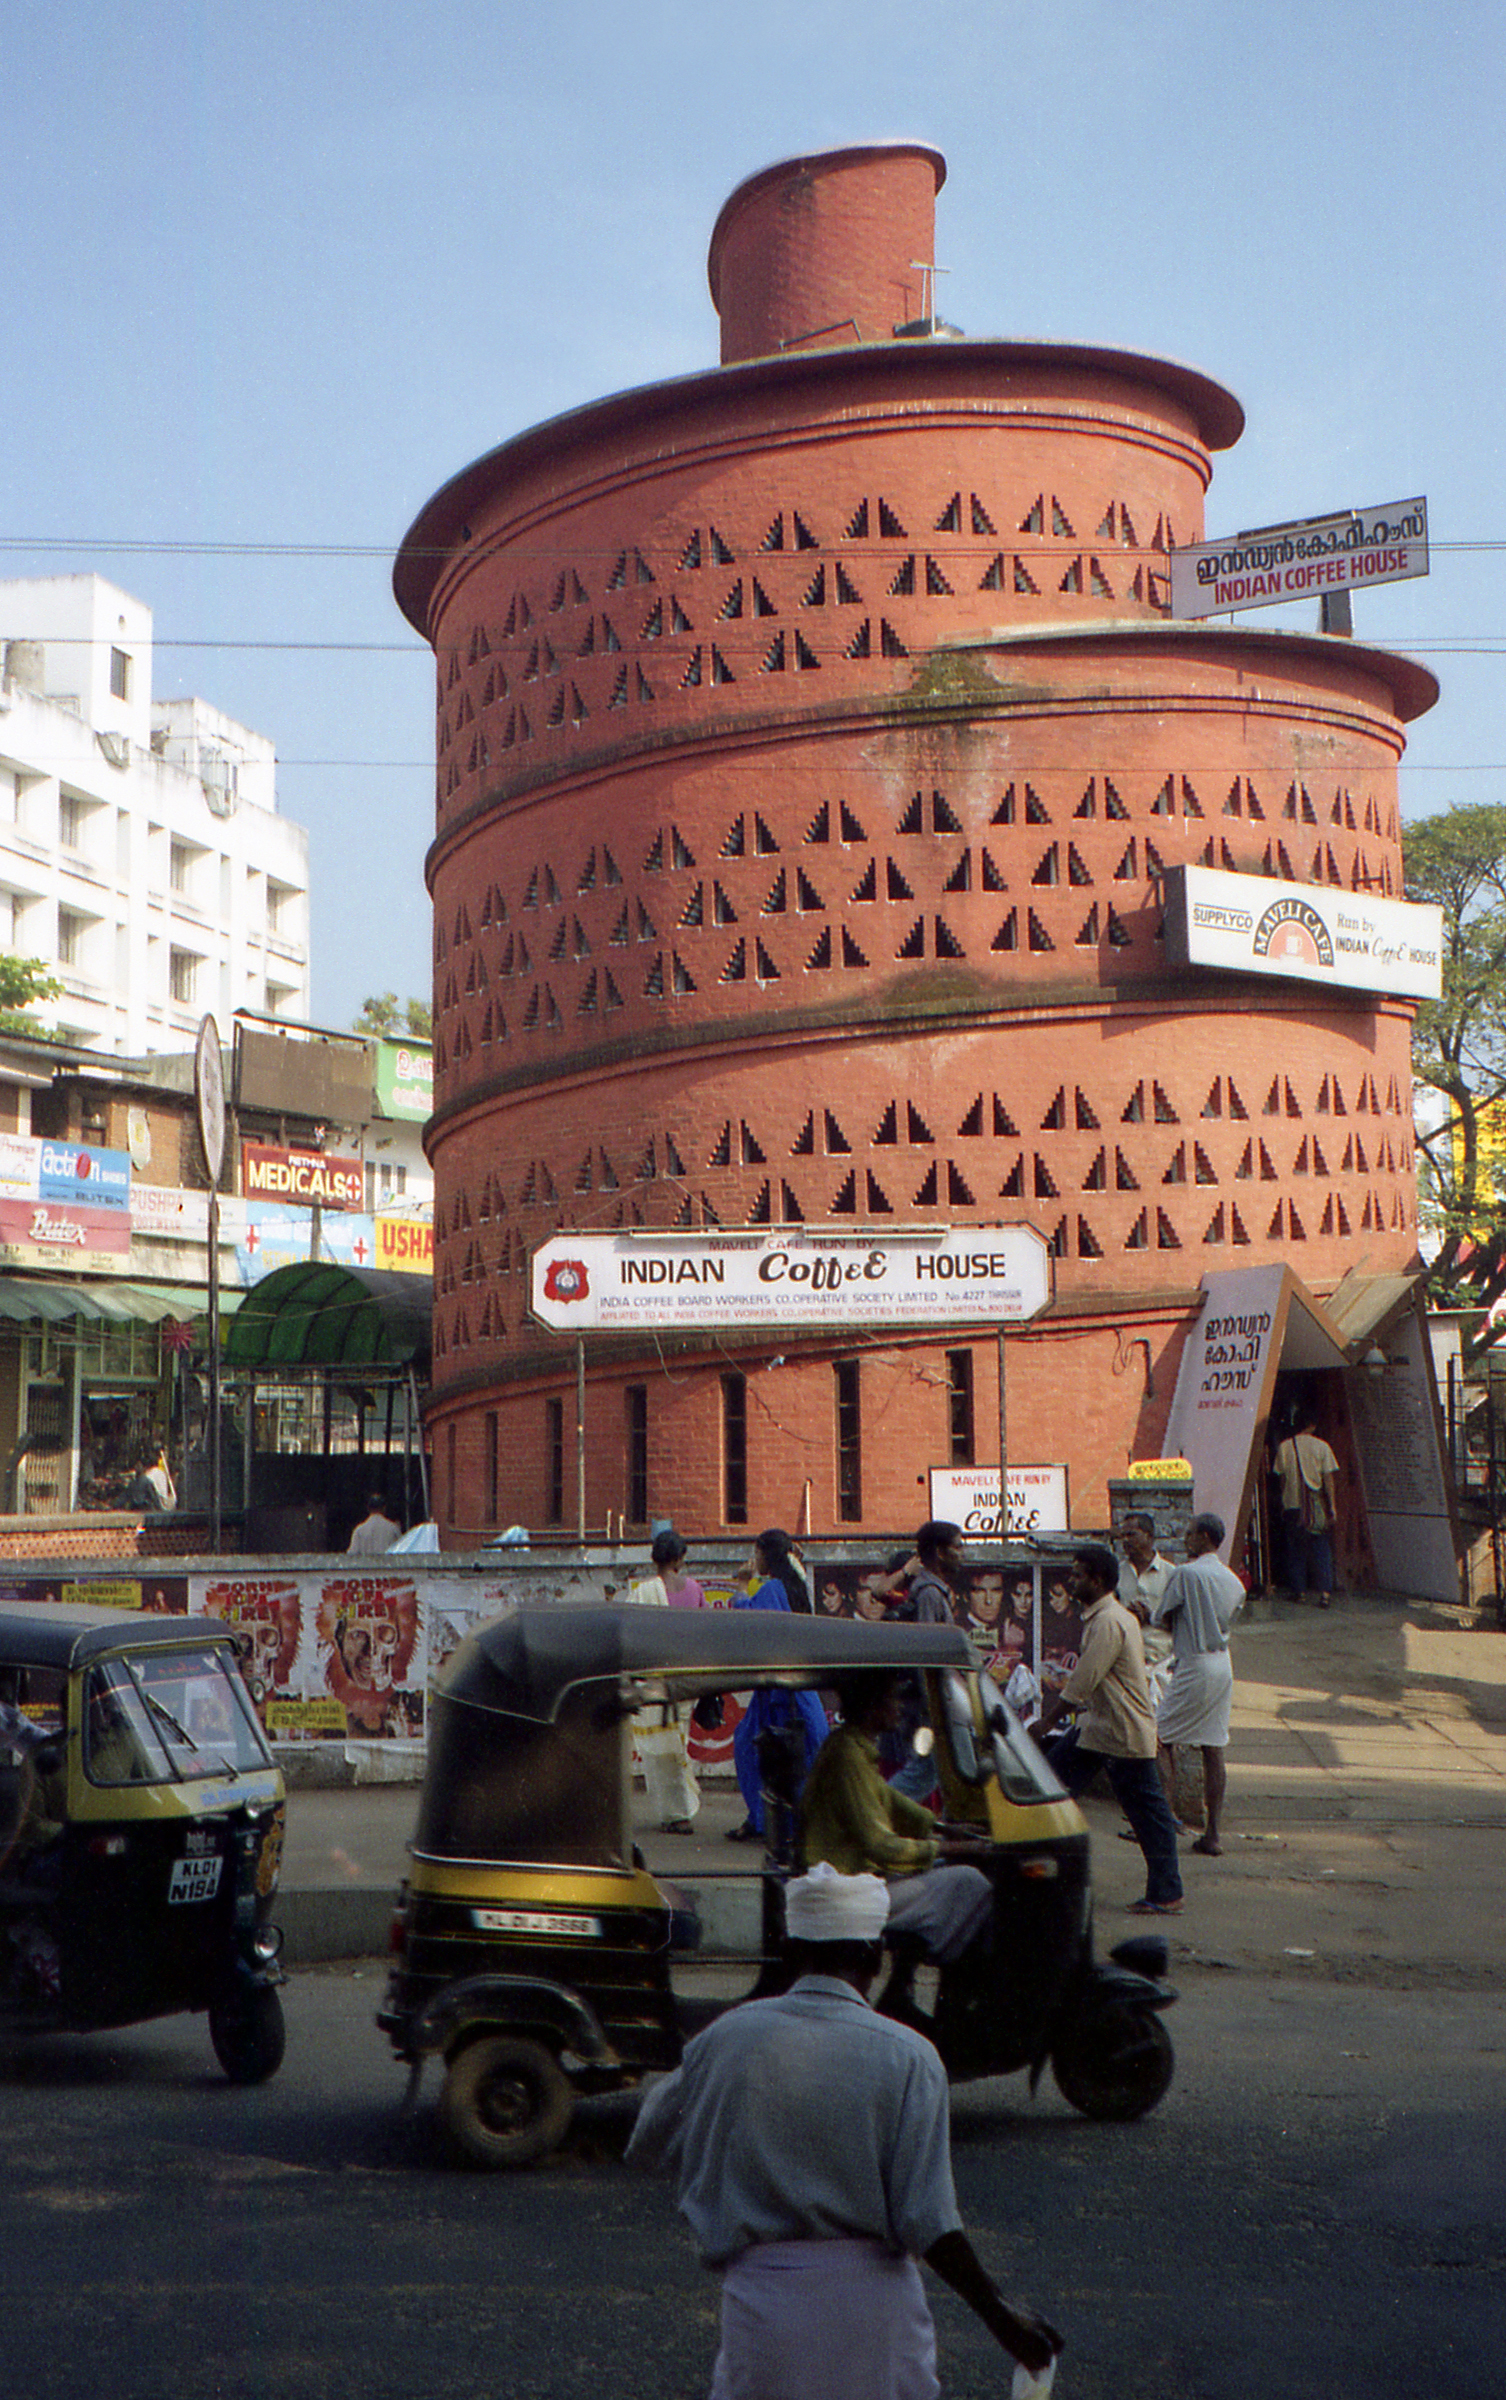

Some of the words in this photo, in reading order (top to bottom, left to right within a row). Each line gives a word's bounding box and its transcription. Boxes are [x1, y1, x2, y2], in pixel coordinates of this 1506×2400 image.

[1214, 571, 1281, 606] INDIAN
[1284, 558, 1346, 592] COFFEE
[1350, 549, 1409, 580] HOUSE
[1193, 906, 1254, 929] SUPPLYCO
[1255, 900, 1302, 954] MAVELI
[1337, 912, 1360, 931] Run
[1362, 917, 1376, 935] by
[1336, 936, 1370, 955] INDIAN
[1409, 947, 1438, 966] HOUSE
[248, 1159, 347, 1201] MEDICALS
[709, 1237, 759, 1251] MAVELI
[767, 1237, 803, 1250] CAFE
[812, 1236, 847, 1250] RUN
[857, 1236, 876, 1249] BY
[621, 1258, 725, 1284] INDIAN
[916, 1253, 1006, 1279] HOUSE
[600, 1296, 630, 1307] INDIA
[634, 1295, 673, 1307] COFFEE
[678, 1295, 712, 1306] BOARD
[853, 1291, 894, 1303] SOCIETY
[898, 1290, 938, 1302] LIMITED
[951, 1474, 994, 1487] MAVELI
[1023, 1474, 1040, 1485] RUN
[1041, 1473, 1052, 1485] BY
[973, 1492, 1027, 1508] INDIAN
[216, 1579, 274, 1595] BORN
[331, 1576, 391, 1591] BORN
